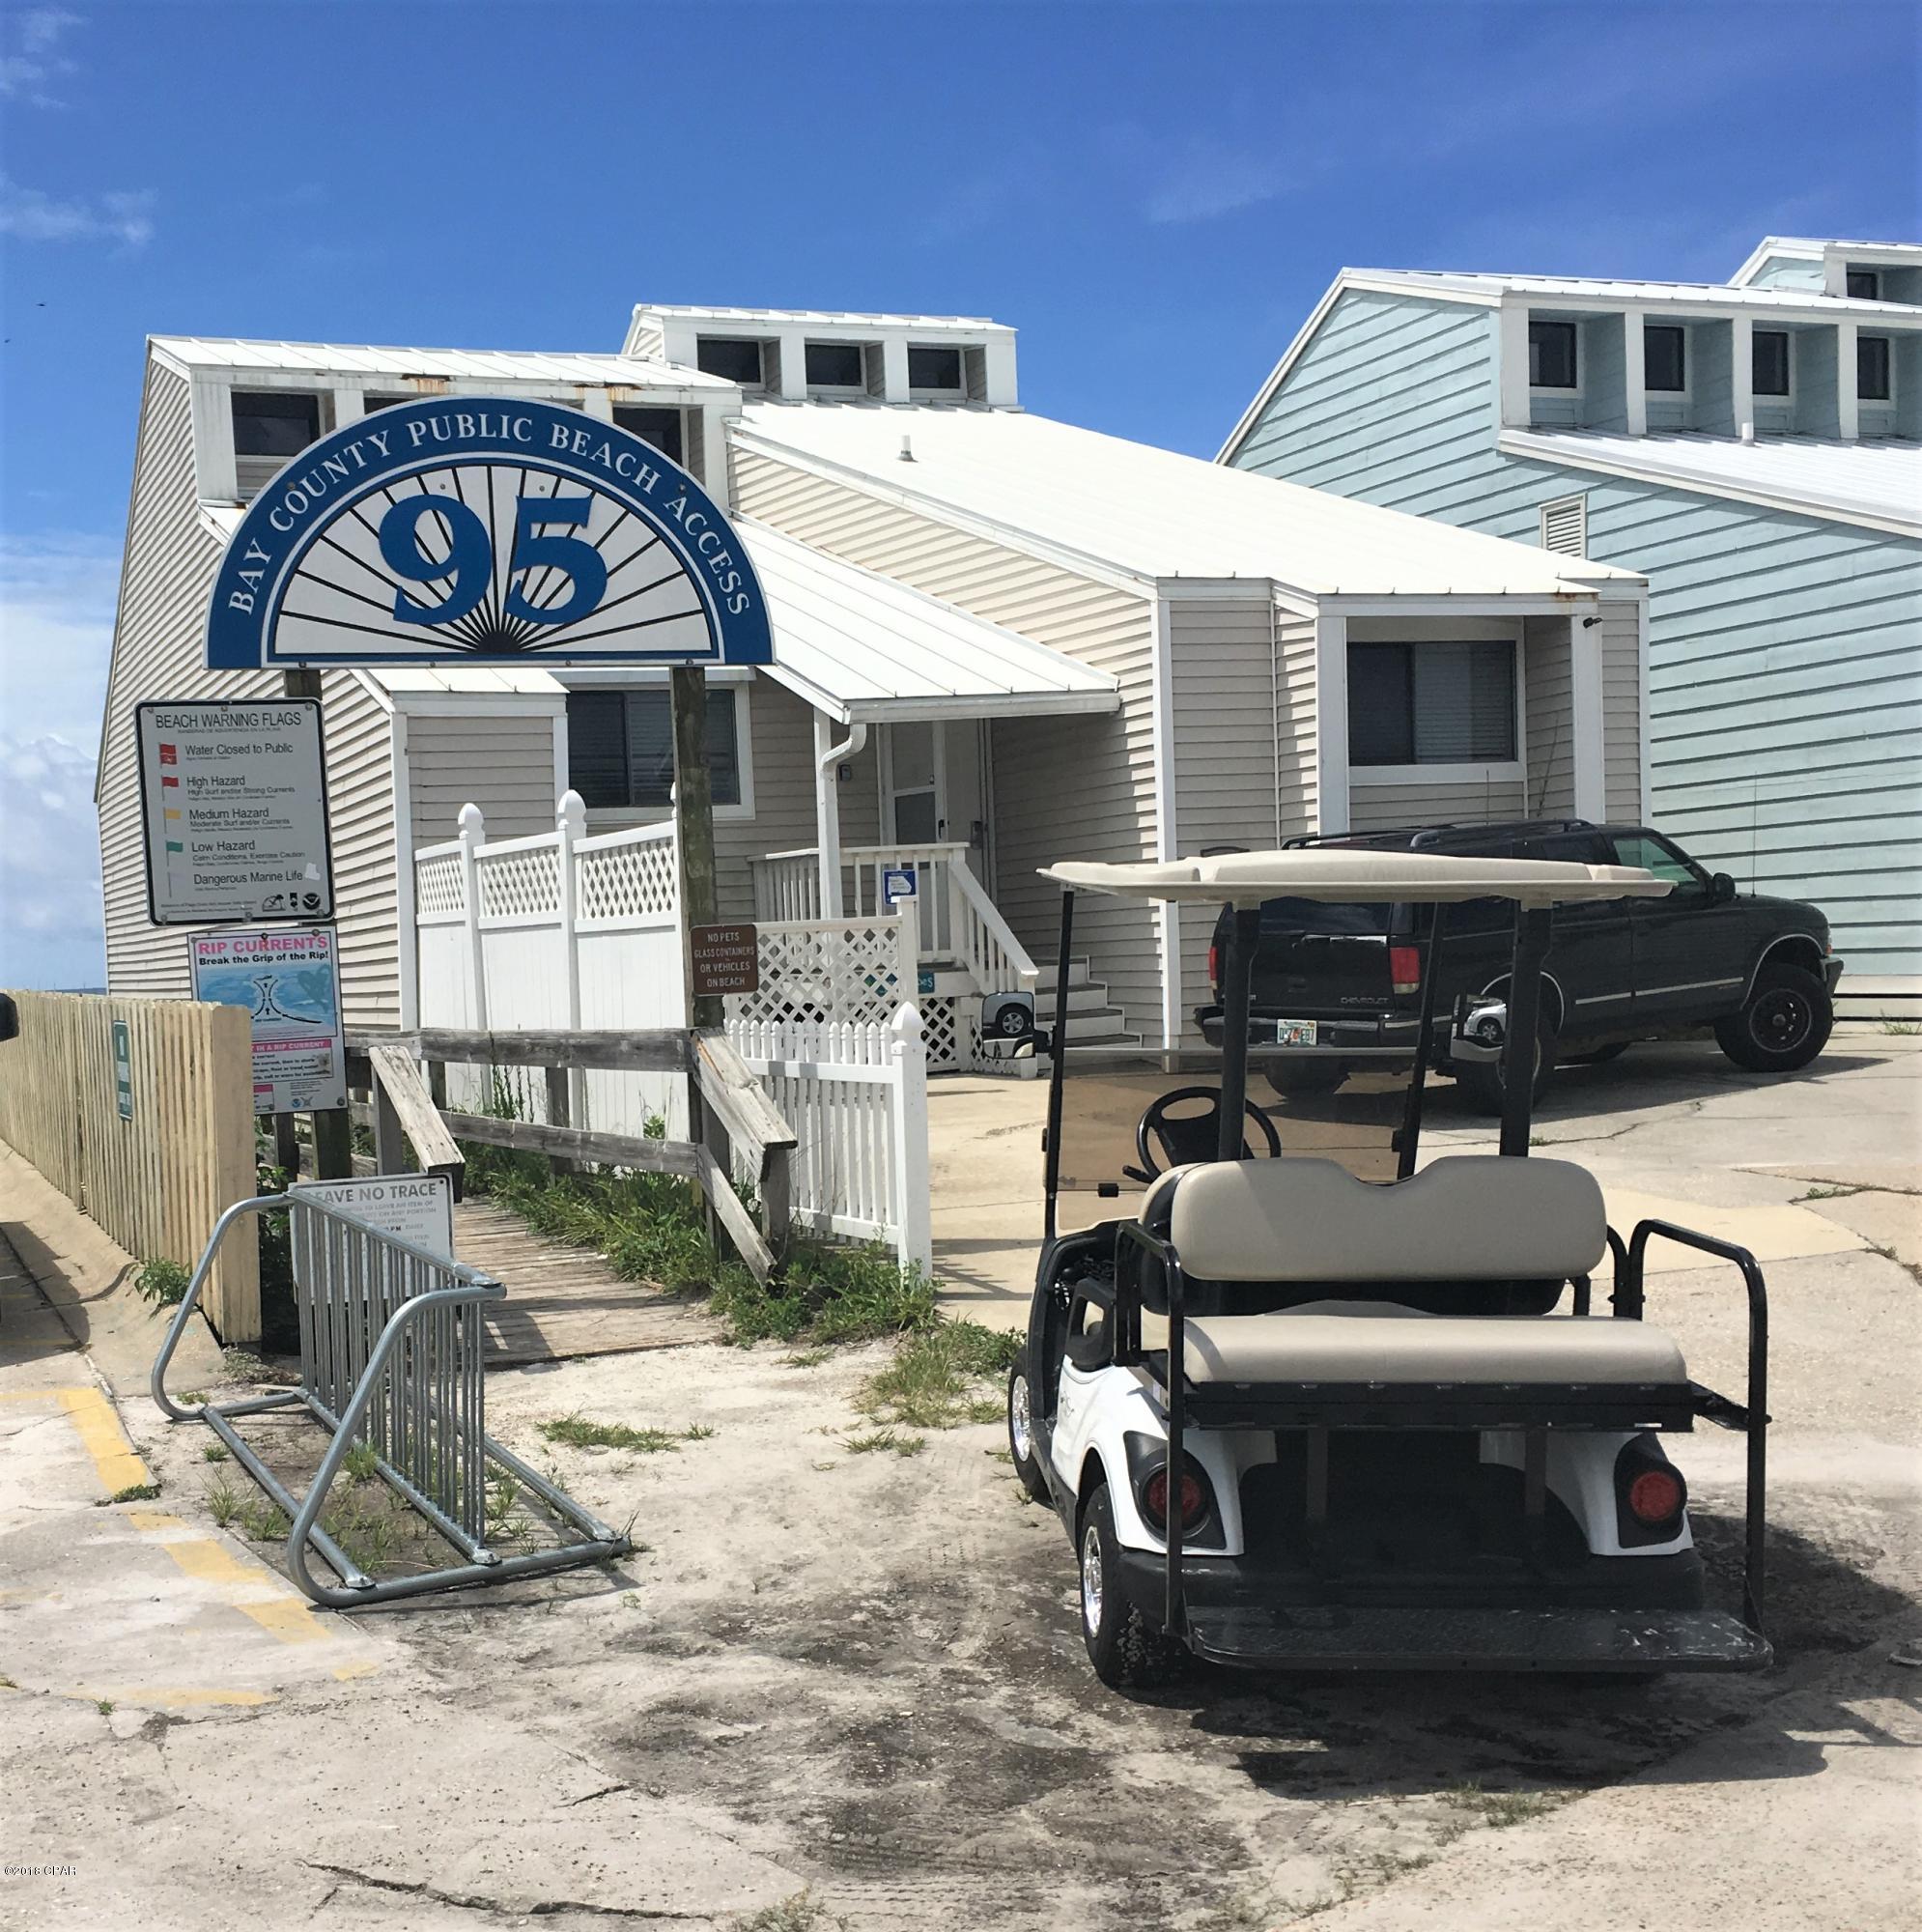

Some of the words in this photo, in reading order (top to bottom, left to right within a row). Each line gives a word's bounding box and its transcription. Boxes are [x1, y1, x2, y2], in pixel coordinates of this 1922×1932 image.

[228, 541, 272, 617] BAY
[269, 429, 392, 532] COUNTY
[409, 412, 533, 448] PUBLIC
[548, 424, 663, 495] BEACH
[664, 495, 750, 616] ACCESS
[378, 494, 608, 626] 95
[155, 714, 198, 728] BEACH
[201, 713, 259, 727] WARNING
[262, 712, 301, 726] FLAGS
[185, 744, 213, 755] Water
[216, 743, 250, 754] Closed
[253, 743, 262, 753] to
[265, 742, 294, 753] Public
[186, 776, 209, 788] High
[212, 776, 245, 786] Hazard
[187, 788, 204, 797] High
[189, 809, 229, 820] Medium
[232, 808, 269, 818] Hazard
[191, 841, 213, 852] Low
[216, 839, 256, 851] Hazard
[193, 872, 247, 887] Dangerous
[250, 871, 283, 883] Marine
[286, 869, 303, 882] Life
[707, 933, 719, 943] NO
[720, 931, 740, 942] PETS
[198, 942, 227, 954] RIP
[233, 936, 328, 953] CURRENTS
[198, 956, 230, 965] Break
[232, 954, 249, 964] the
[252, 953, 273, 965] Grip
[276, 952, 287, 961] of
[289, 952, 306, 960] the
[309, 951, 329, 961] Rip!
[693, 949, 715, 958] GLASS
[716, 947, 755, 957] CONTAINERS
[699, 963, 712, 974] OR
[713, 961, 750, 973] VEHICLES
[706, 978, 718, 987] ON
[719, 977, 746, 987] BEACH
[288, 1041, 325, 1050] CURRENT
[359, 1186, 384, 1201] NO
[389, 1182, 437, 1199] TRACE
